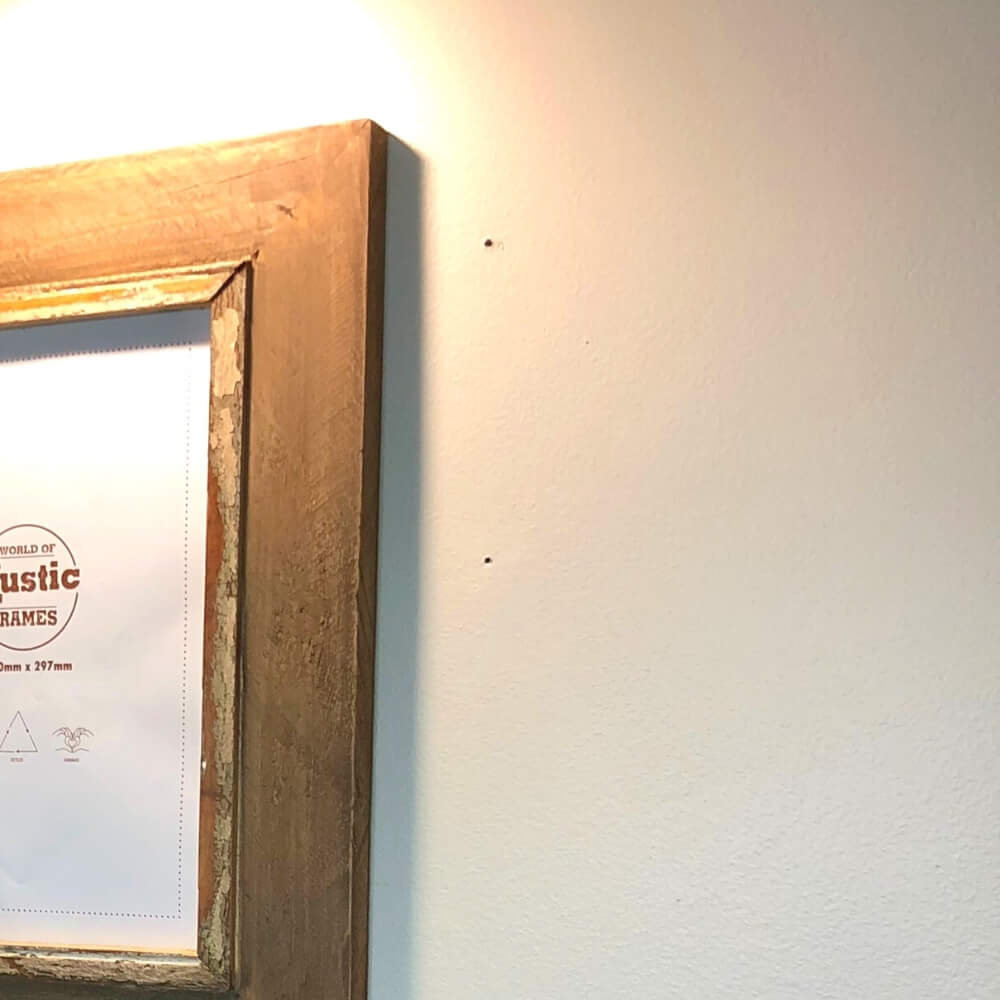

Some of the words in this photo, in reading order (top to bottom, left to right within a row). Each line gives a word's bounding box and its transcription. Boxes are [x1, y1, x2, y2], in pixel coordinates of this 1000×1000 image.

[0, 544, 39, 555] WORLD
[41, 543, 56, 554] OF
[25, 664, 31, 672] x
[34, 660, 73, 672] 297mm
